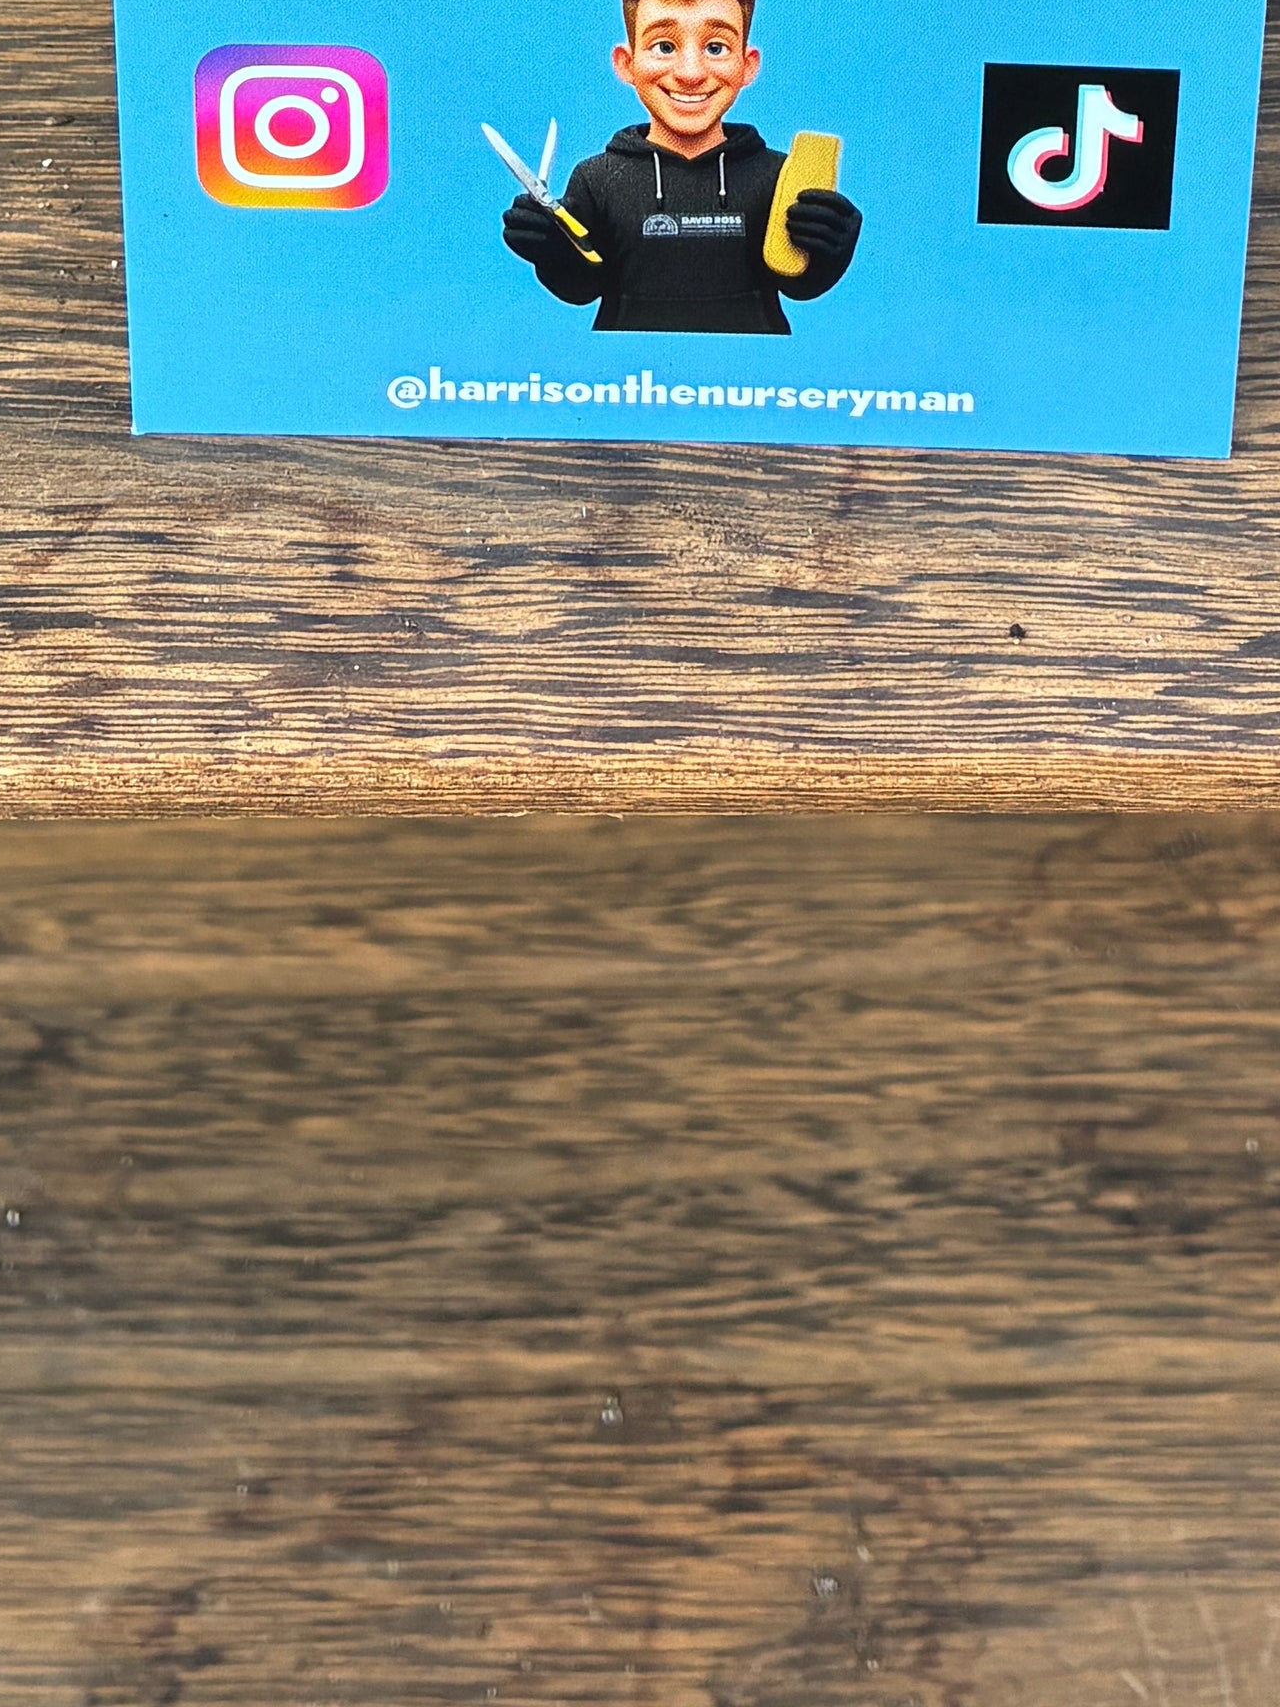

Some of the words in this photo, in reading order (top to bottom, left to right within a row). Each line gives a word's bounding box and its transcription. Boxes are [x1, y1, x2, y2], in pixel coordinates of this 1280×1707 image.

[681, 216, 713, 225] DAVID
[714, 216, 742, 225] ROSS
[386, 365, 975, 418] @harrisonthenurseryman
